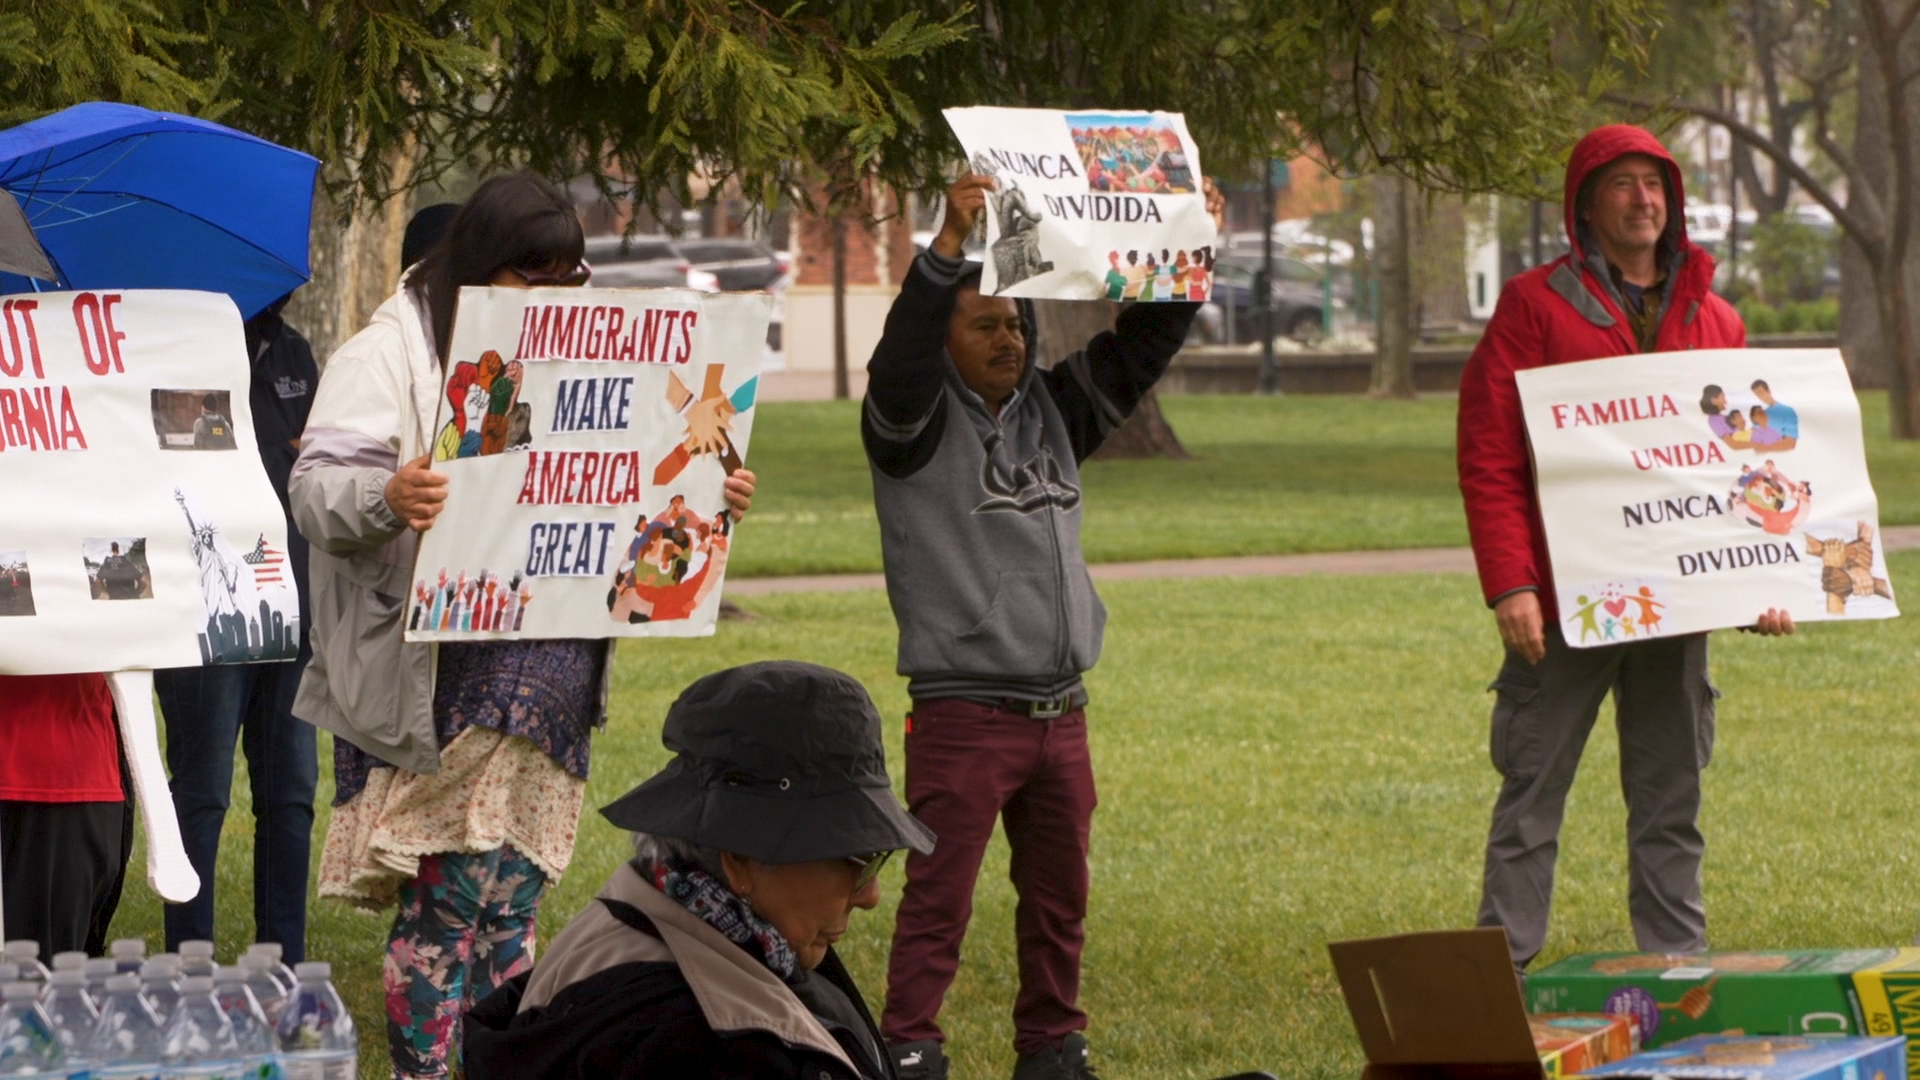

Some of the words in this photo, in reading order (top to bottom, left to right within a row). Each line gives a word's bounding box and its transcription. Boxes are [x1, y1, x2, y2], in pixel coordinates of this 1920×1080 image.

[989, 147, 1079, 180] NUNCA
[1043, 193, 1163, 223] DIVIDIDA
[72, 291, 126, 375] OF
[515, 305, 698, 364] IMMIGRANTS
[0, 386, 88, 451] RNIA
[551, 377, 635, 432] MAKE
[1551, 394, 1679, 430] FAMILIA
[516, 451, 640, 505] AMERICA
[1631, 441, 1727, 471] UNIDA
[1622, 494, 1723, 528] NUNCA
[525, 522, 615, 577] GREAT
[1677, 541, 1800, 577] DIVIDIDA
